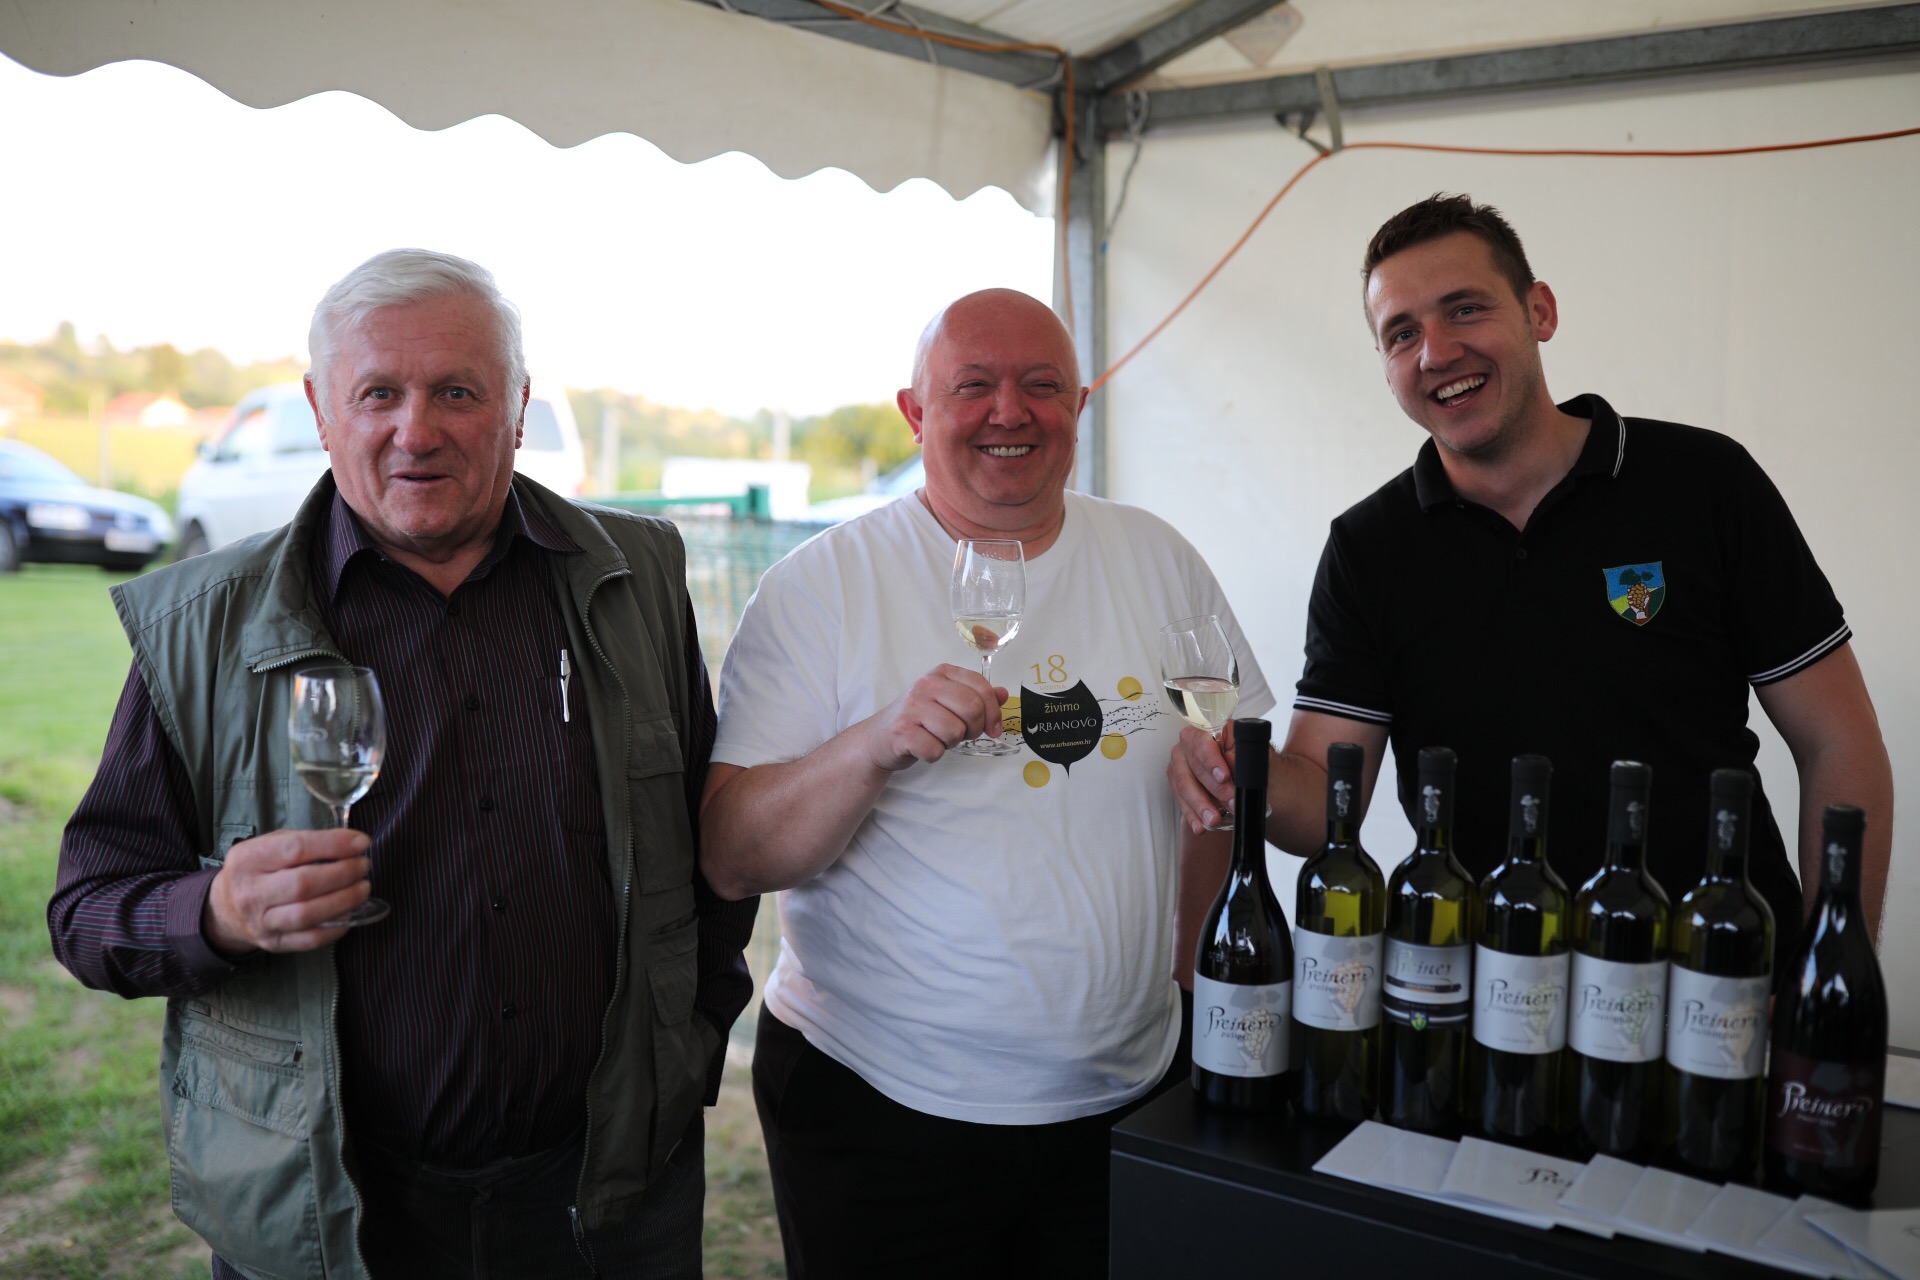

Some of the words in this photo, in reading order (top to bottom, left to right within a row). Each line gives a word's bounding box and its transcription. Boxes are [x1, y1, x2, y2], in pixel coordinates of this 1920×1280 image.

[1030, 654, 1067, 684] 18
[1044, 702, 1080, 714] živimo
[1040, 738, 1092, 749] www.urbanovo.hr
